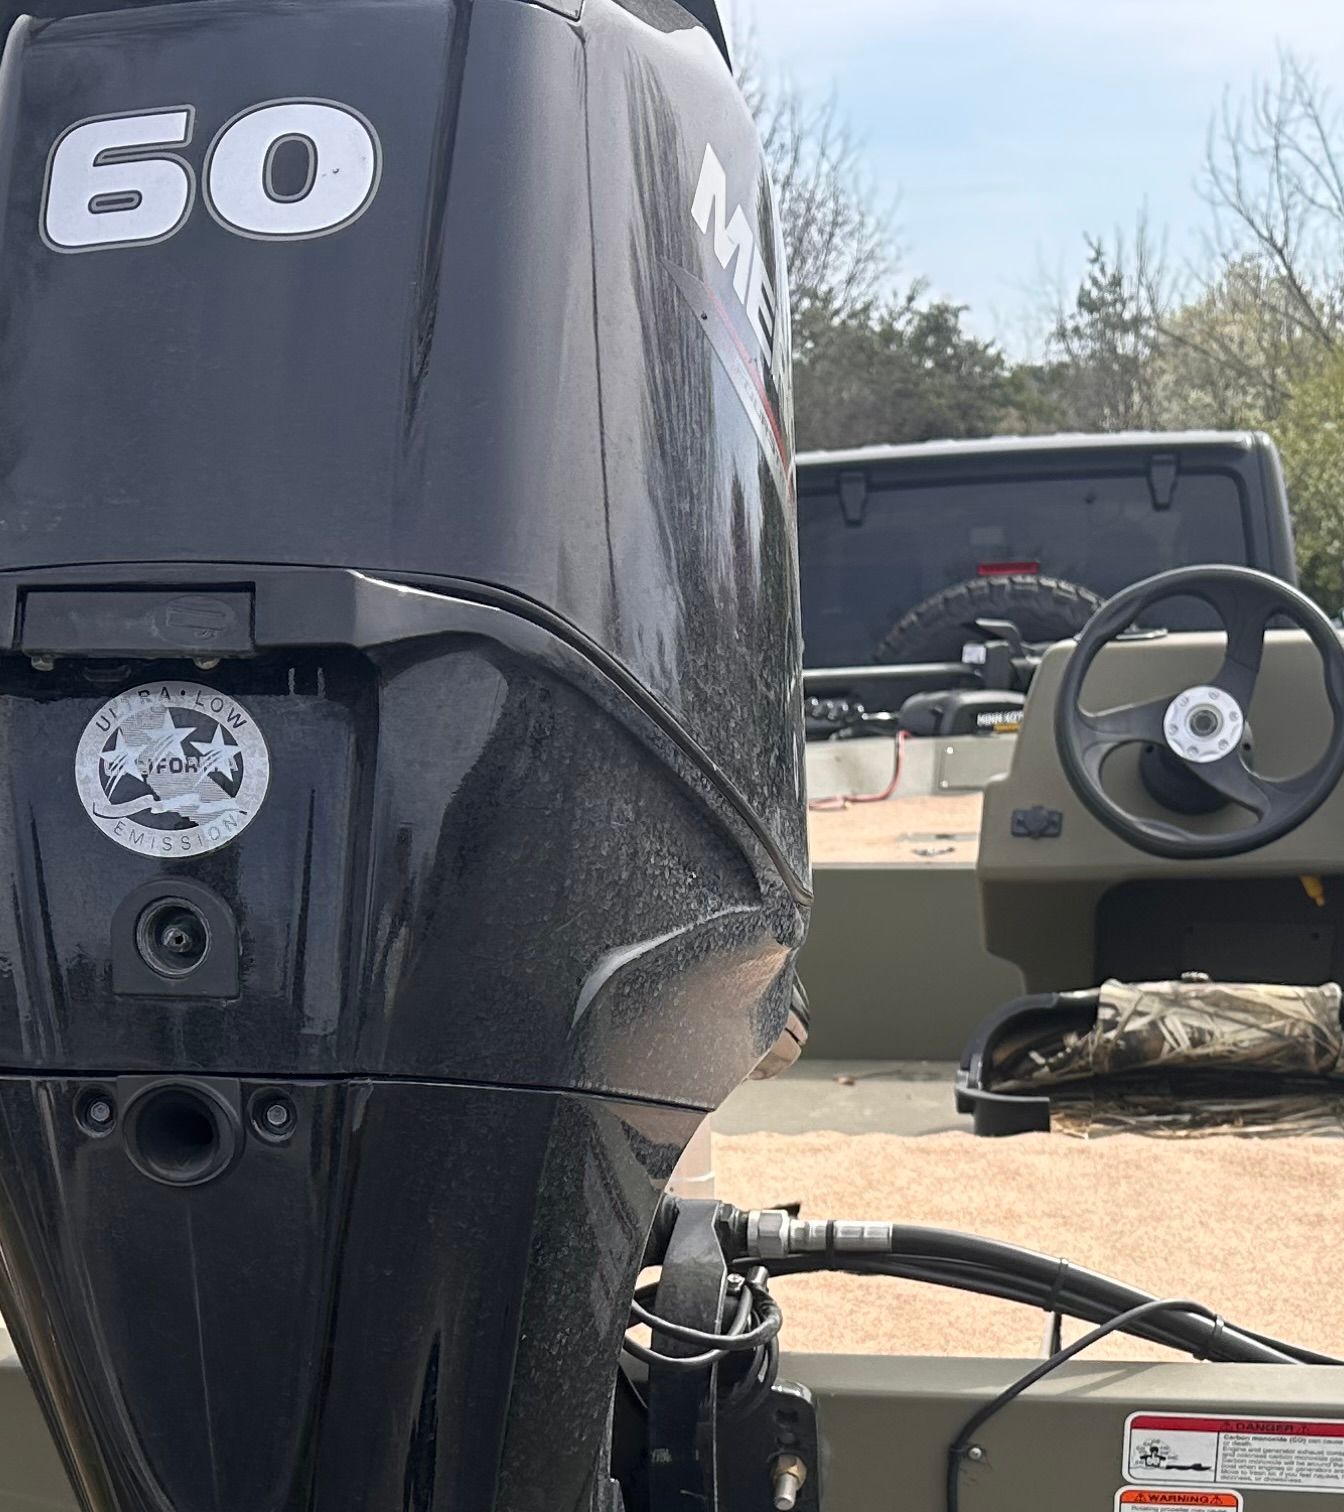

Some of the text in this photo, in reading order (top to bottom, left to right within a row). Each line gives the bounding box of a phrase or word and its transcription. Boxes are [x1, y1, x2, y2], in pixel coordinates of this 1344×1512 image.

[40, 98, 381, 252] 60
[195, 690, 247, 728] LOW
[114, 813, 237, 851] EMISSION
[1236, 1422, 1294, 1433] DANGER
[1148, 1494, 1209, 1504] WARNING
